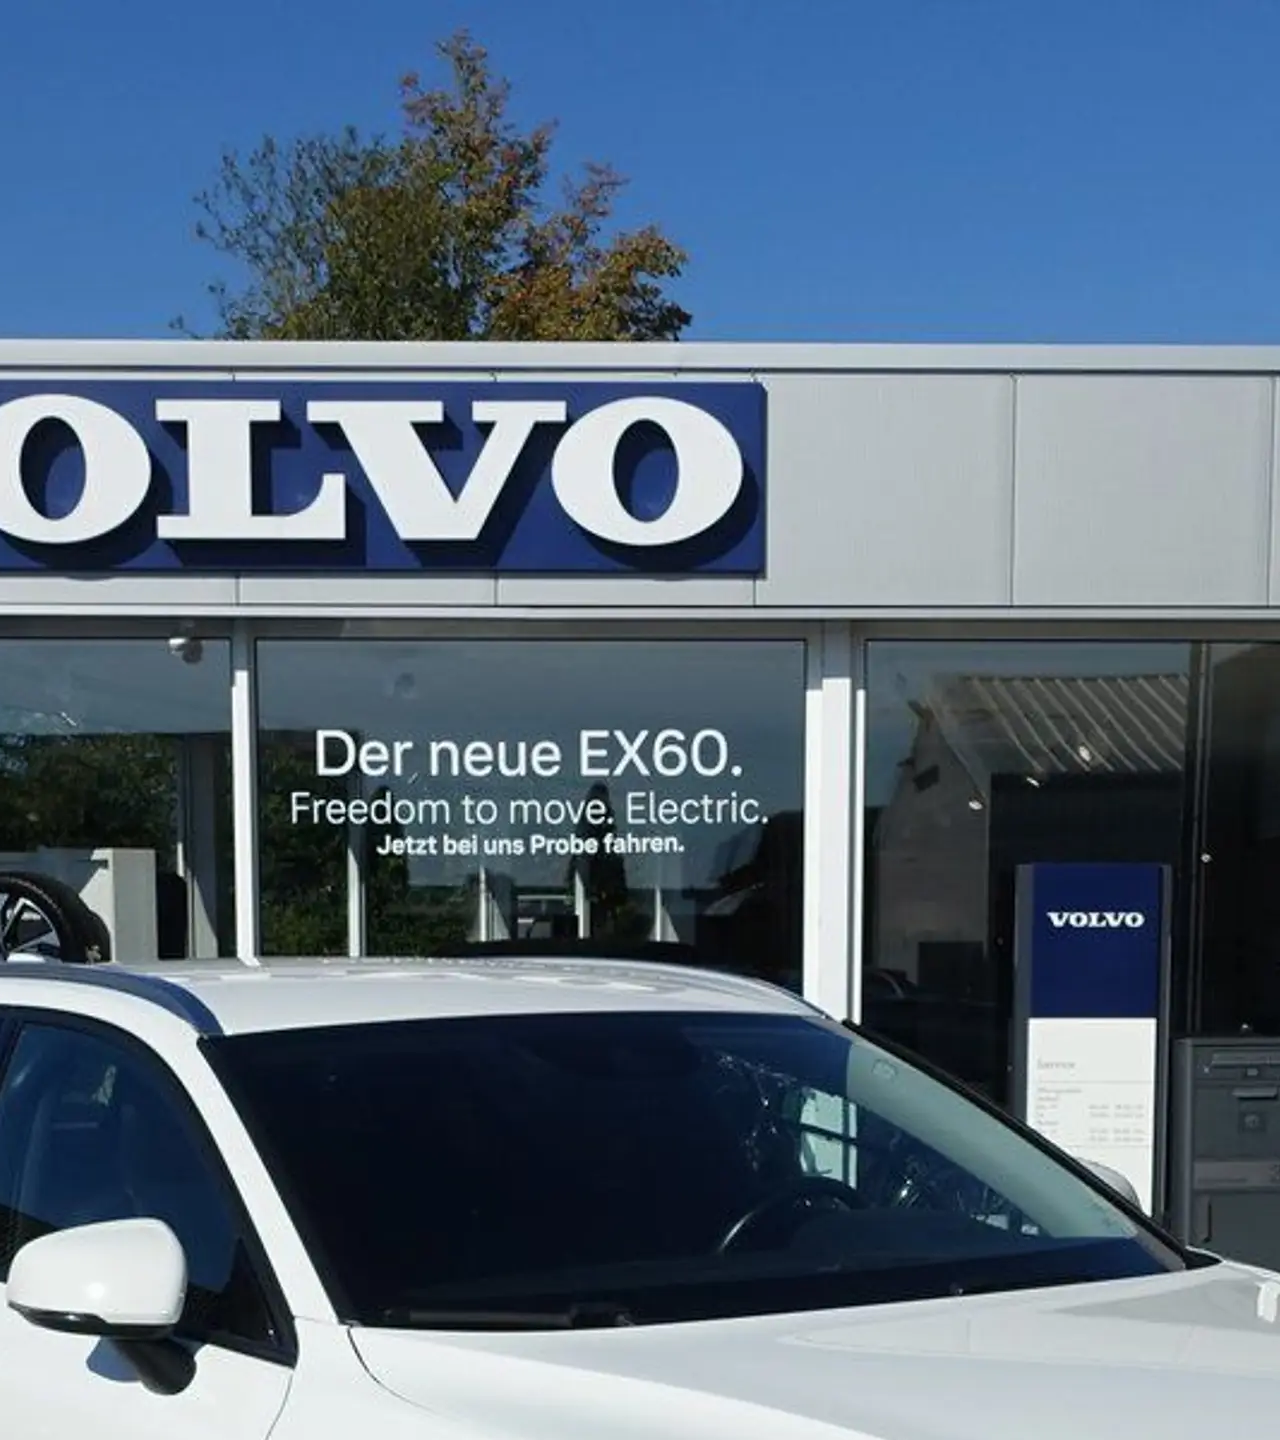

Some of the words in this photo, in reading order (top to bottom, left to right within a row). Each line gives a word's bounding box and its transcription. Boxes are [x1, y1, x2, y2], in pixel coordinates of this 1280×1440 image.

[315, 729, 413, 777] Der
[428, 739, 562, 777] neue
[579, 729, 743, 777] EX60.
[291, 790, 450, 825] Freedom
[461, 794, 498, 825] to
[509, 799, 614, 825] move.
[626, 790, 769, 825] Electric.
[376, 834, 438, 856] Jetzt
[443, 832, 478, 856] bei
[483, 837, 525, 856] uns
[530, 832, 598, 856] Probe
[603, 832, 685, 855] fahren.
[1046, 911, 1145, 928] VOLVO
